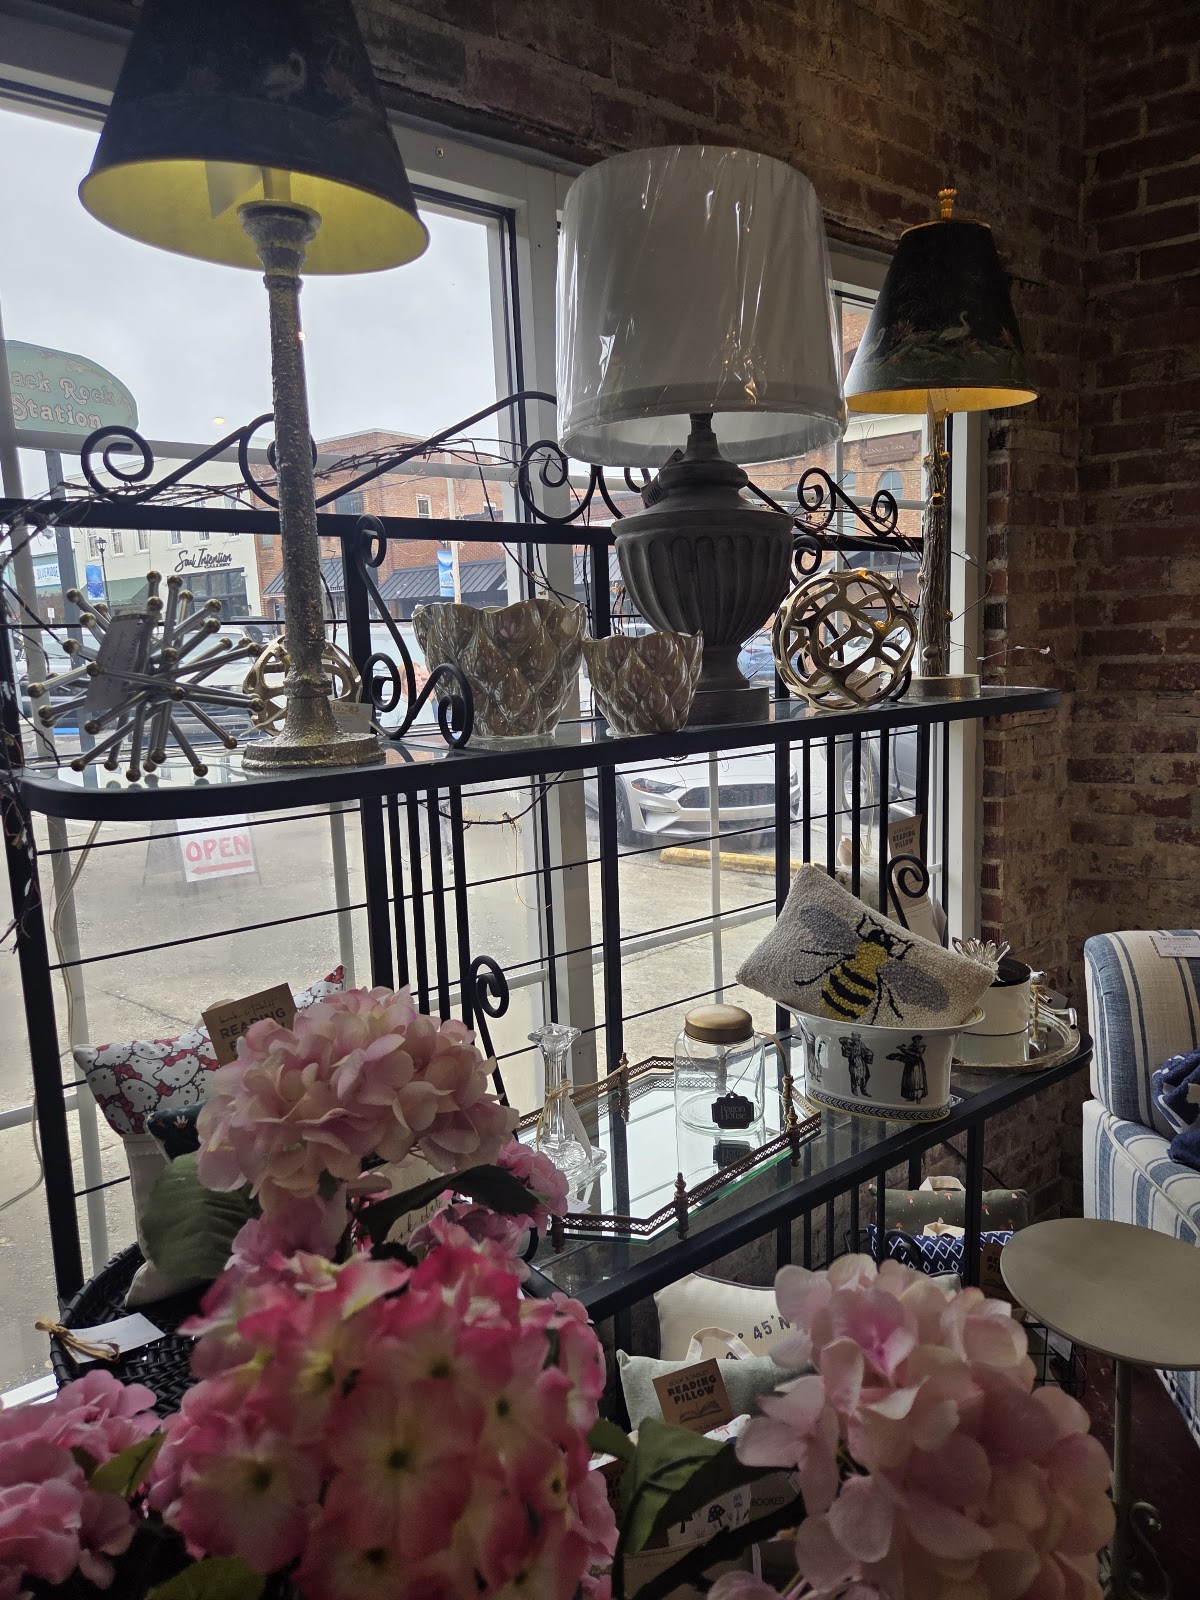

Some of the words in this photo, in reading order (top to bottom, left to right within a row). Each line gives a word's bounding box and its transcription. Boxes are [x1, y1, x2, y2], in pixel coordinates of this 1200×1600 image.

[11, 370, 52, 393] ack
[59, 377, 115, 405] Rock
[11, 393, 103, 429] Station
[174, 549, 197, 573] Soul
[198, 547, 233, 568] Intention
[185, 834, 251, 863] OPEN
[720, 1110, 747, 1120] House
[667, 1374, 717, 1397] READING
[673, 1384, 715, 1405] PILLOW
[751, 1496, 785, 1507] BOOKED
